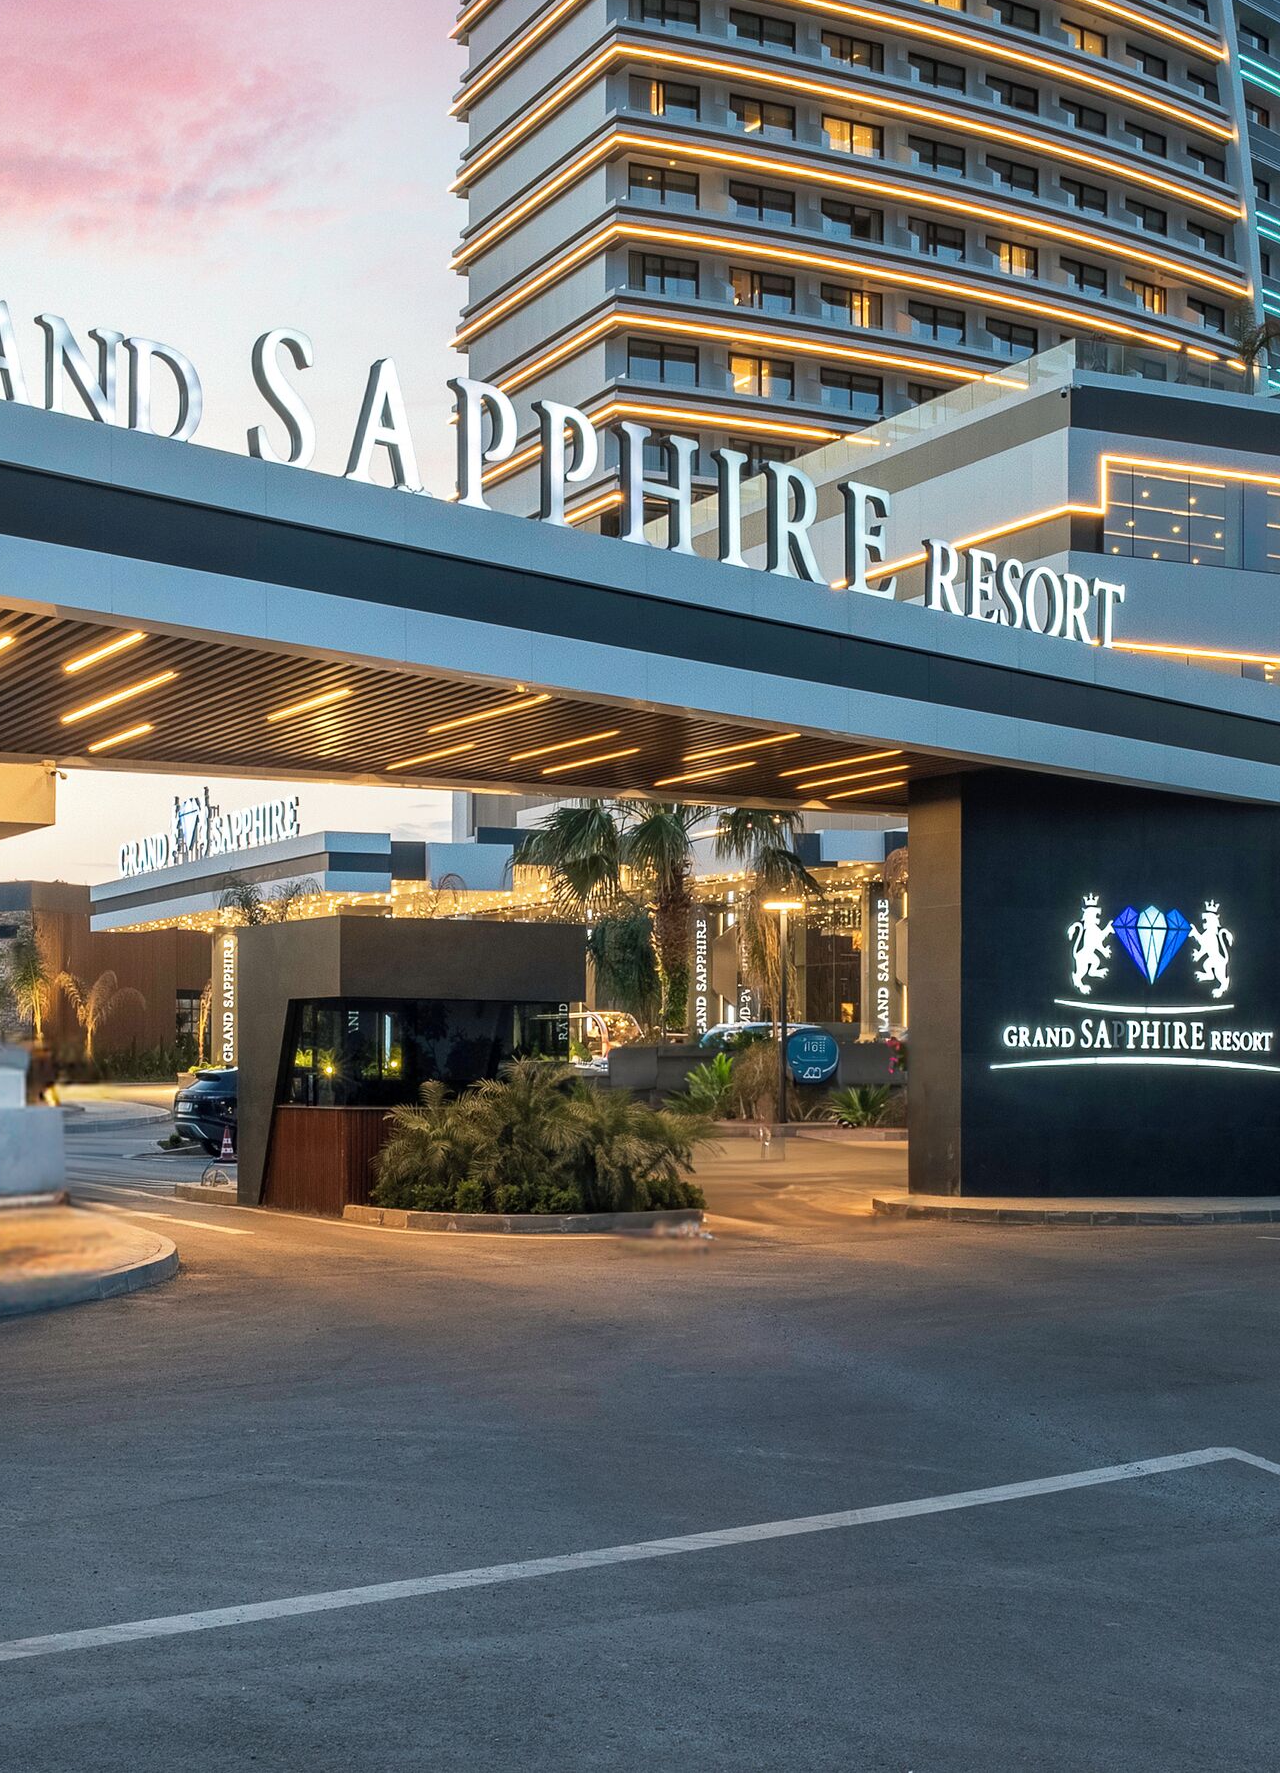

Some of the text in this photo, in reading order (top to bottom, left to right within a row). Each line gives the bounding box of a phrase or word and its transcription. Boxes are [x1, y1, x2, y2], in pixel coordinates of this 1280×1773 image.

[247, 327, 897, 601] SAPPHIRE
[921, 537, 1125, 649] RESORT
[119, 795, 300, 879] GRAND SAPPHIRE
[696, 919, 707, 993] SAPPHIRE
[877, 898, 889, 983] SAPPHIRE
[222, 938, 234, 1063] GRAND SAPPHIRE
[1002, 1018, 1274, 1052] GRAND SAPPHIRE RESORT
